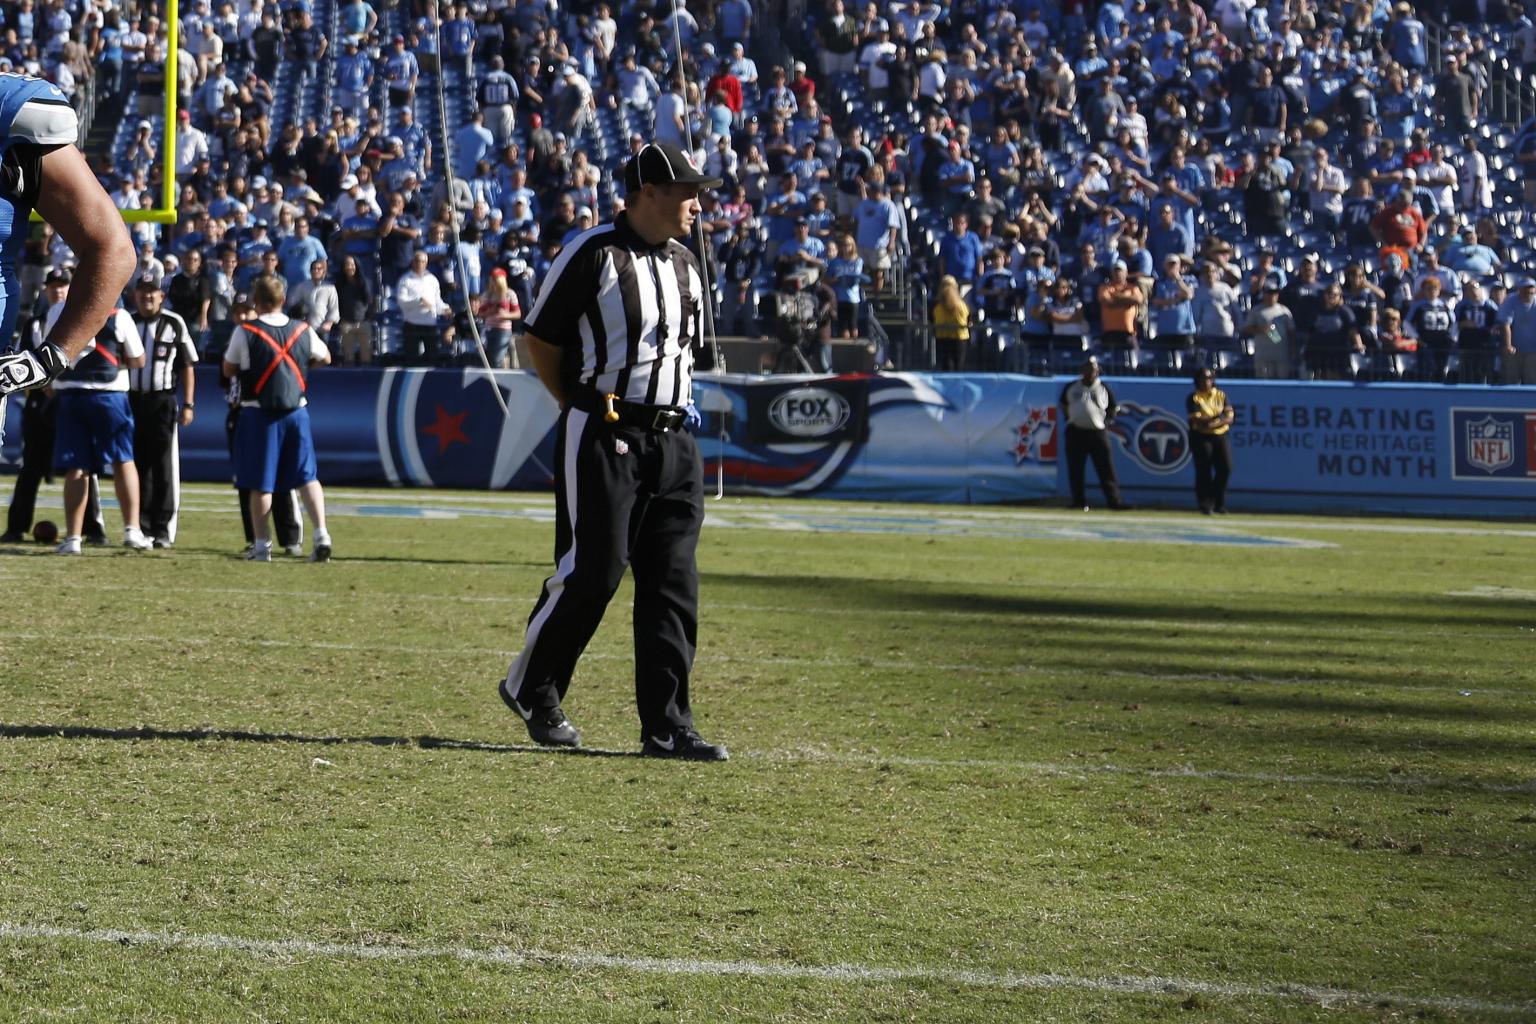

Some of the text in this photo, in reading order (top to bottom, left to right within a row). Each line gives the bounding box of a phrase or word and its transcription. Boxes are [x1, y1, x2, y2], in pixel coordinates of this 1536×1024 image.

[786, 398, 832, 417] FOX
[1233, 404, 1436, 431] ELEBRATING
[787, 417, 838, 426] SPORTS
[1232, 431, 1437, 453] SPANIC HERITAGE
[1473, 441, 1510, 465] NFL
[1317, 453, 1437, 479] MONTH
